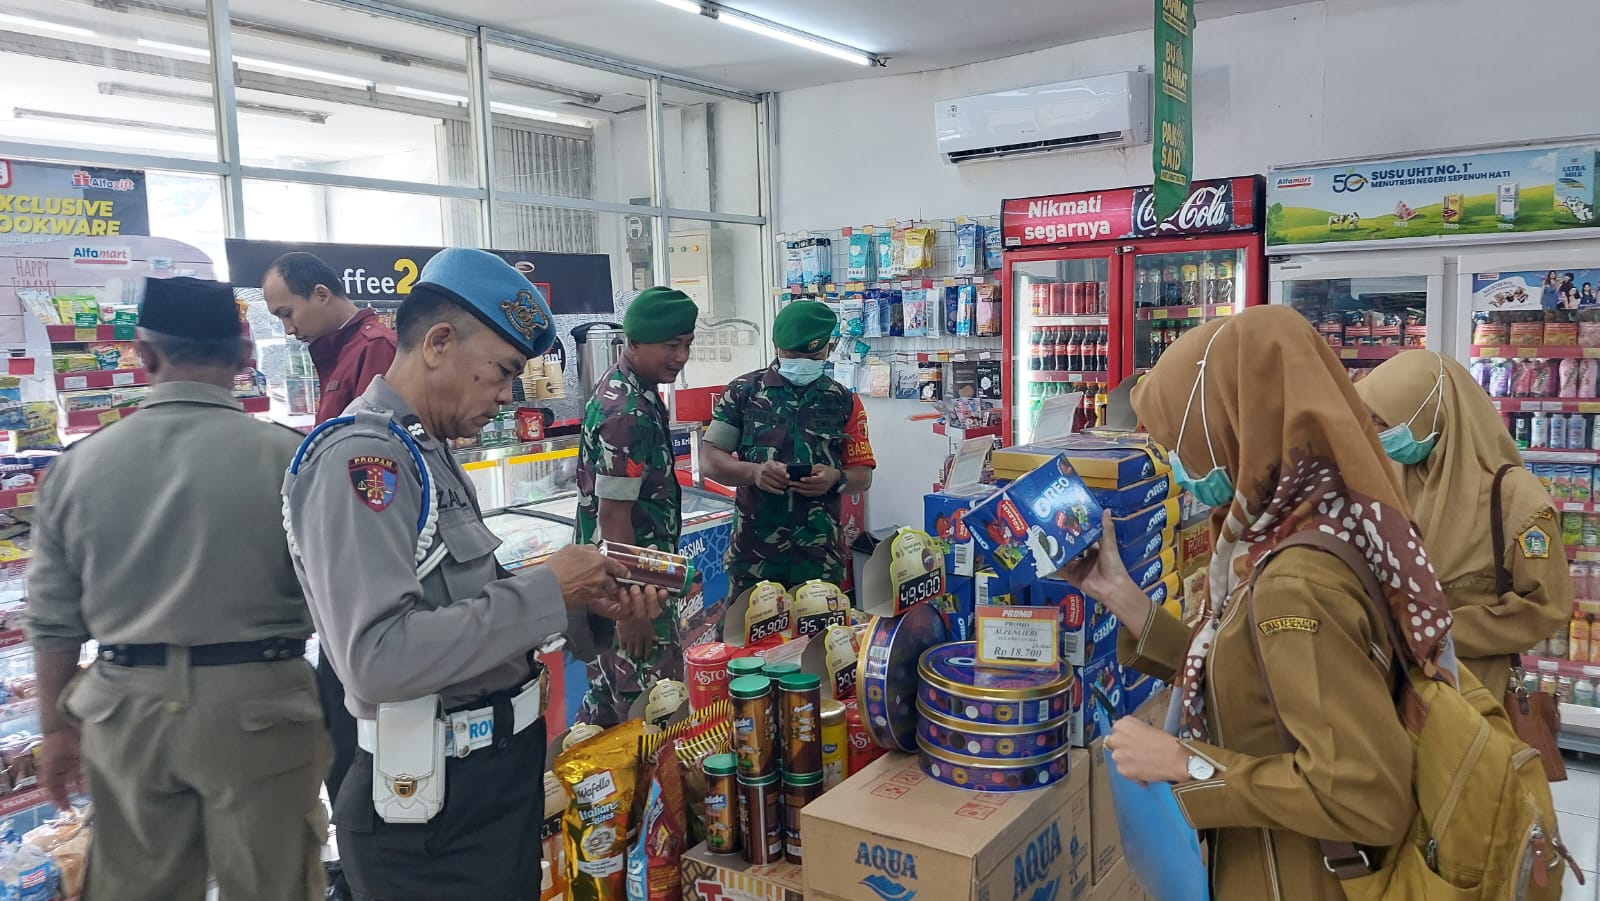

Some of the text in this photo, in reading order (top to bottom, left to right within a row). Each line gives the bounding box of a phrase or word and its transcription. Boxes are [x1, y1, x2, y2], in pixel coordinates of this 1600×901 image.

[1161, 145, 1181, 170] SAID
[1332, 172, 1368, 193] 50
[1371, 169, 1402, 181] SUSU
[1406, 166, 1435, 178] UHT
[1435, 164, 1461, 175] NO.
[1416, 175, 1447, 184] NEGERI
[1447, 172, 1487, 182] SEPENUH
[1488, 170, 1511, 179] HATI
[91, 177, 135, 192] Alfagift
[1028, 194, 1102, 218] Nikmati
[1024, 219, 1110, 242] segarnya
[73, 247, 128, 260] Alfamart
[15, 258, 49, 277] HAPPY
[353, 456, 394, 468] PROPAM
[1034, 476, 1071, 519] OREO
[1144, 480, 1167, 503] OREO
[900, 576, 941, 605] 49.900
[1002, 609, 1033, 618] PROMO
[751, 616, 789, 642] 26.900
[994, 646, 1042, 658] Rp 18.700
[576, 776, 611, 798] Wafello
[855, 841, 918, 880] AQUA
[1013, 820, 1062, 901] AQUA
